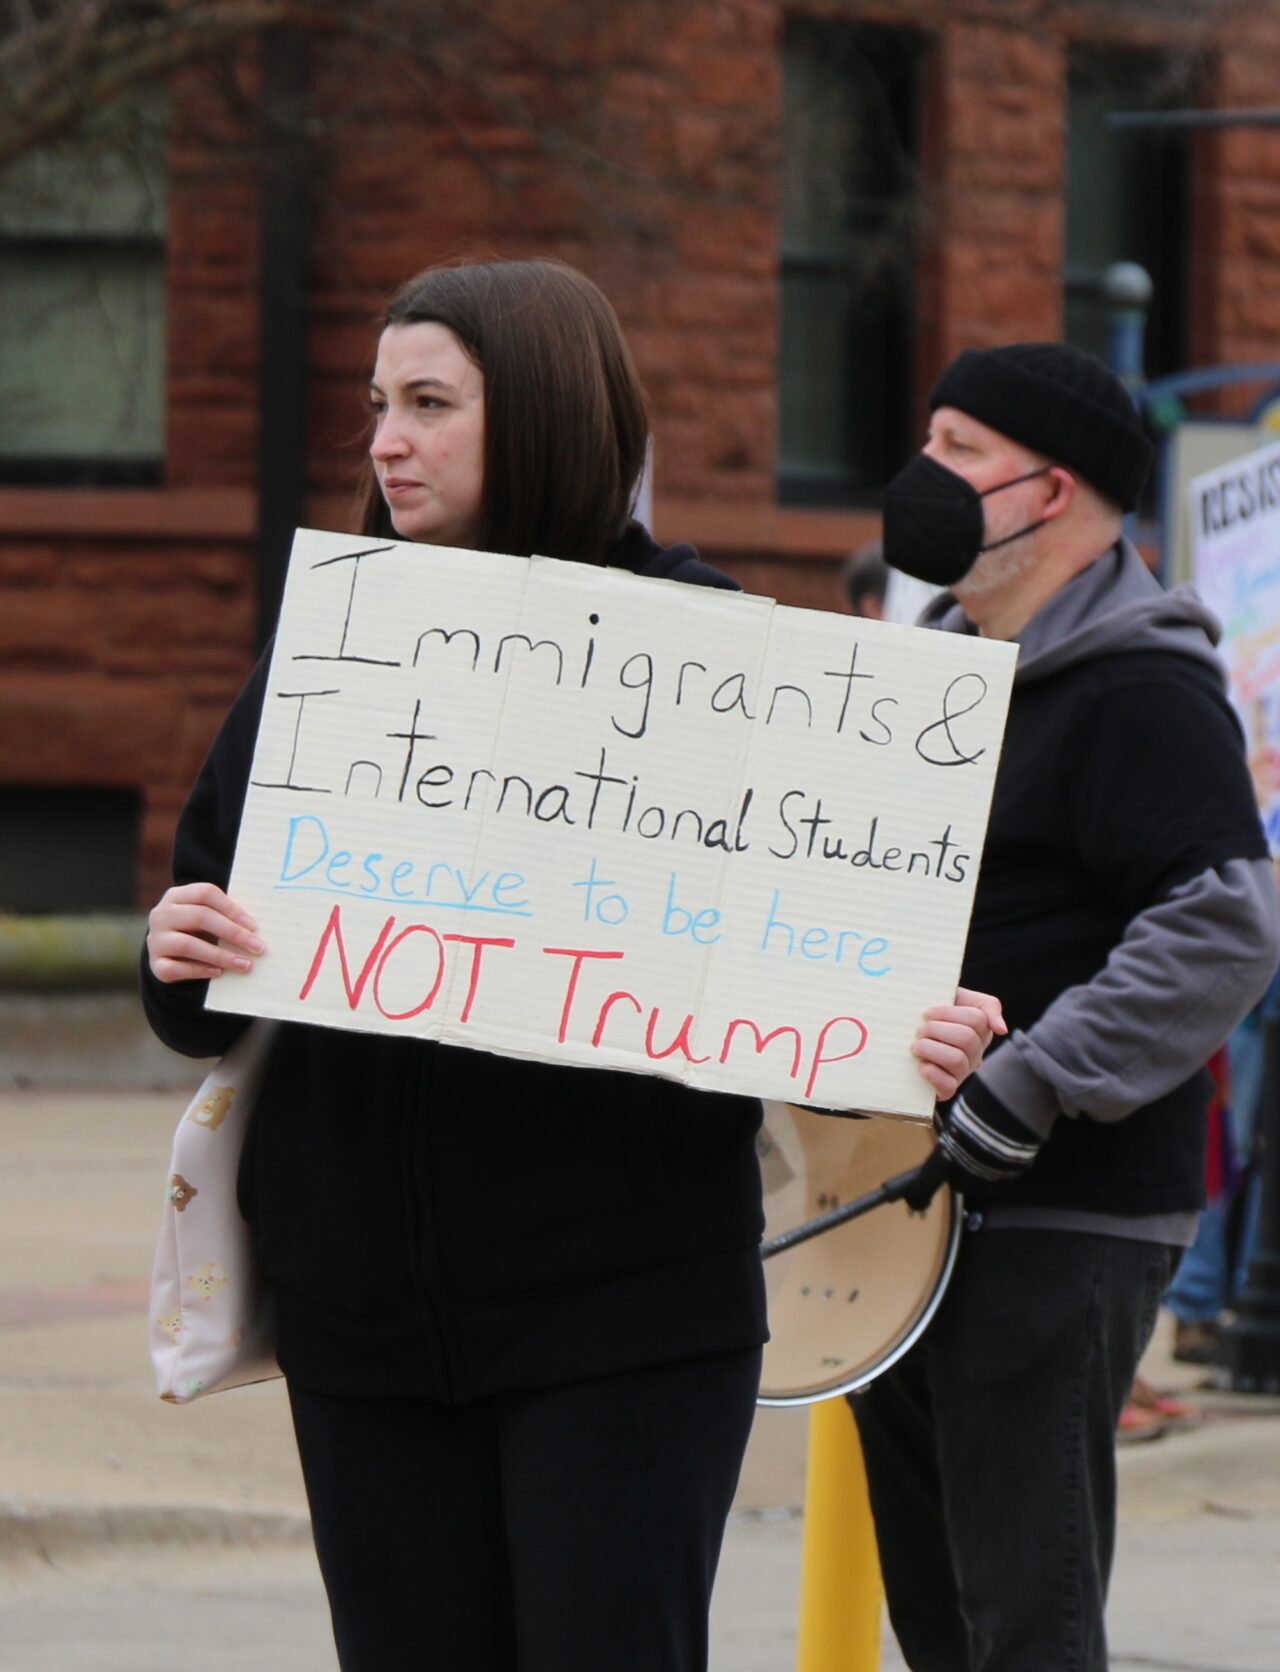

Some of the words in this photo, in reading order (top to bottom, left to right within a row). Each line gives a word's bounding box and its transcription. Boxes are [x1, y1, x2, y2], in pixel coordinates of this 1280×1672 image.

[291, 544, 896, 746] Immigrants
[914, 672, 988, 767] &
[251, 689, 752, 852] International
[769, 790, 971, 884] Students
[274, 815, 531, 912] Deserve
[572, 858, 628, 926] to
[662, 875, 720, 944] be
[762, 890, 893, 978] here
[300, 906, 515, 1023] NOT
[544, 948, 868, 1097] Trump
